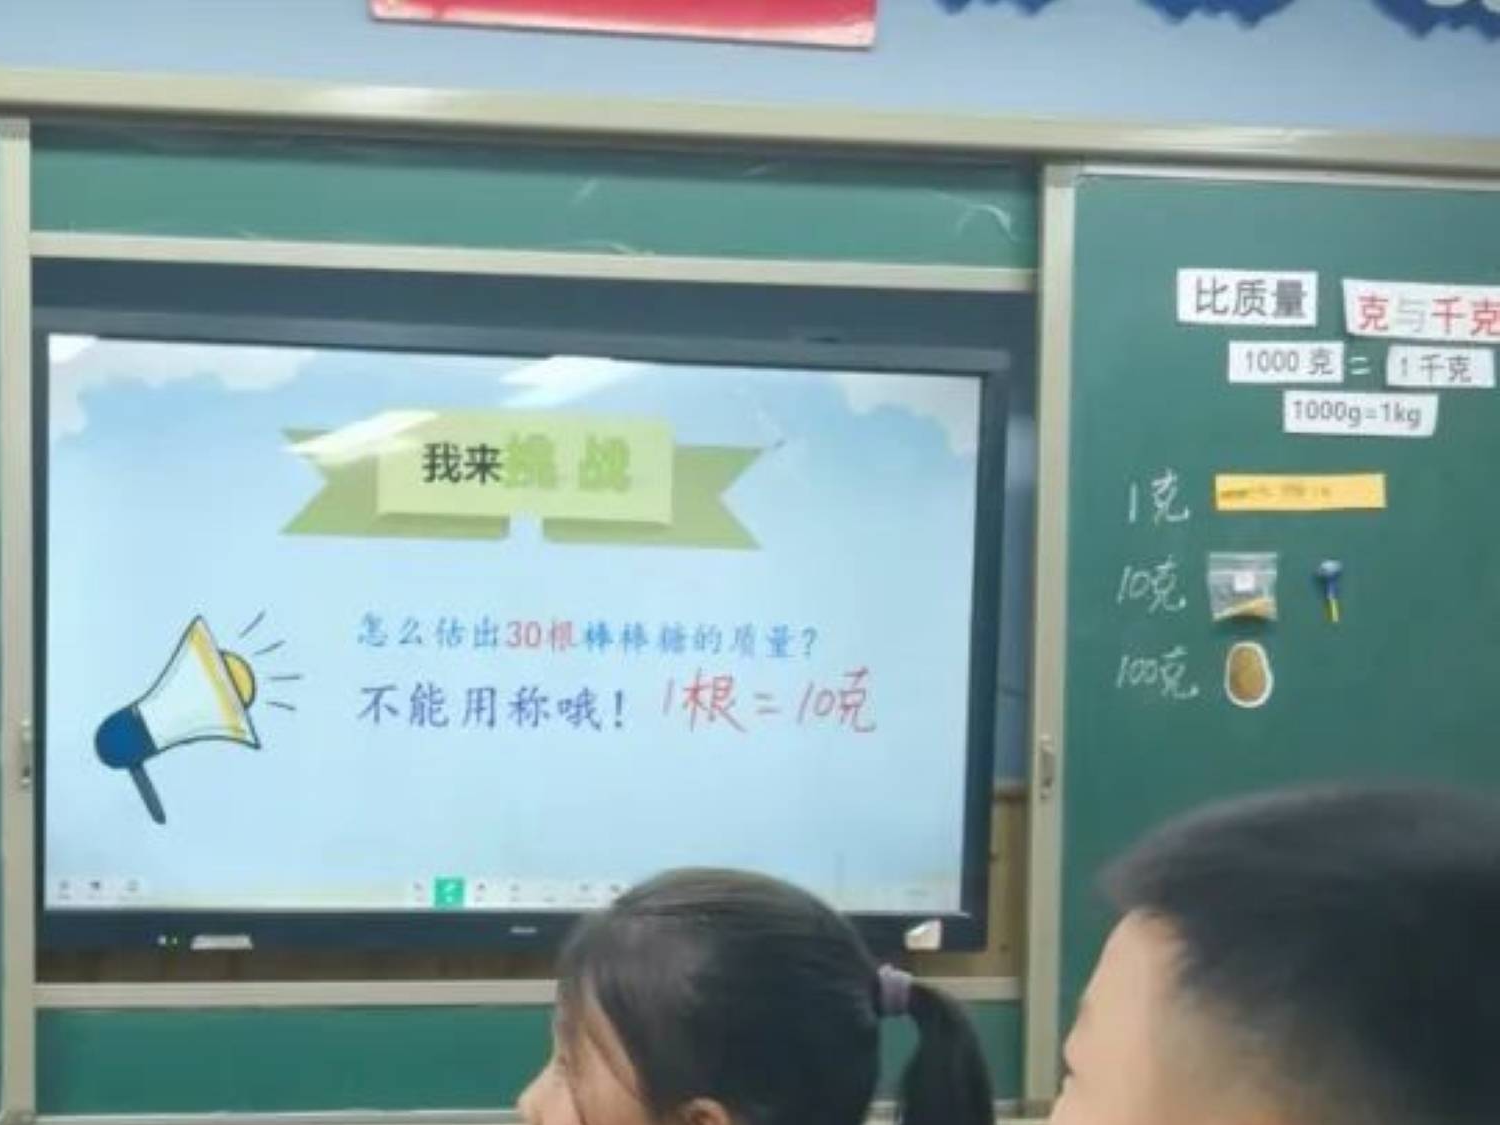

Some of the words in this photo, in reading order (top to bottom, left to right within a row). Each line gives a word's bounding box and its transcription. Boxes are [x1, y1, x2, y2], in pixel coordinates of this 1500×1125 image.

[1194, 277, 1307, 319] 比质量
[1356, 295, 1500, 336] 克与千克
[1292, 398, 1422, 428] 1000g=1kg
[1128, 467, 1190, 525] 1克
[1116, 553, 1187, 614] 10克
[1116, 645, 1199, 700] 100克
[356, 681, 626, 733] 不能用称哦!
